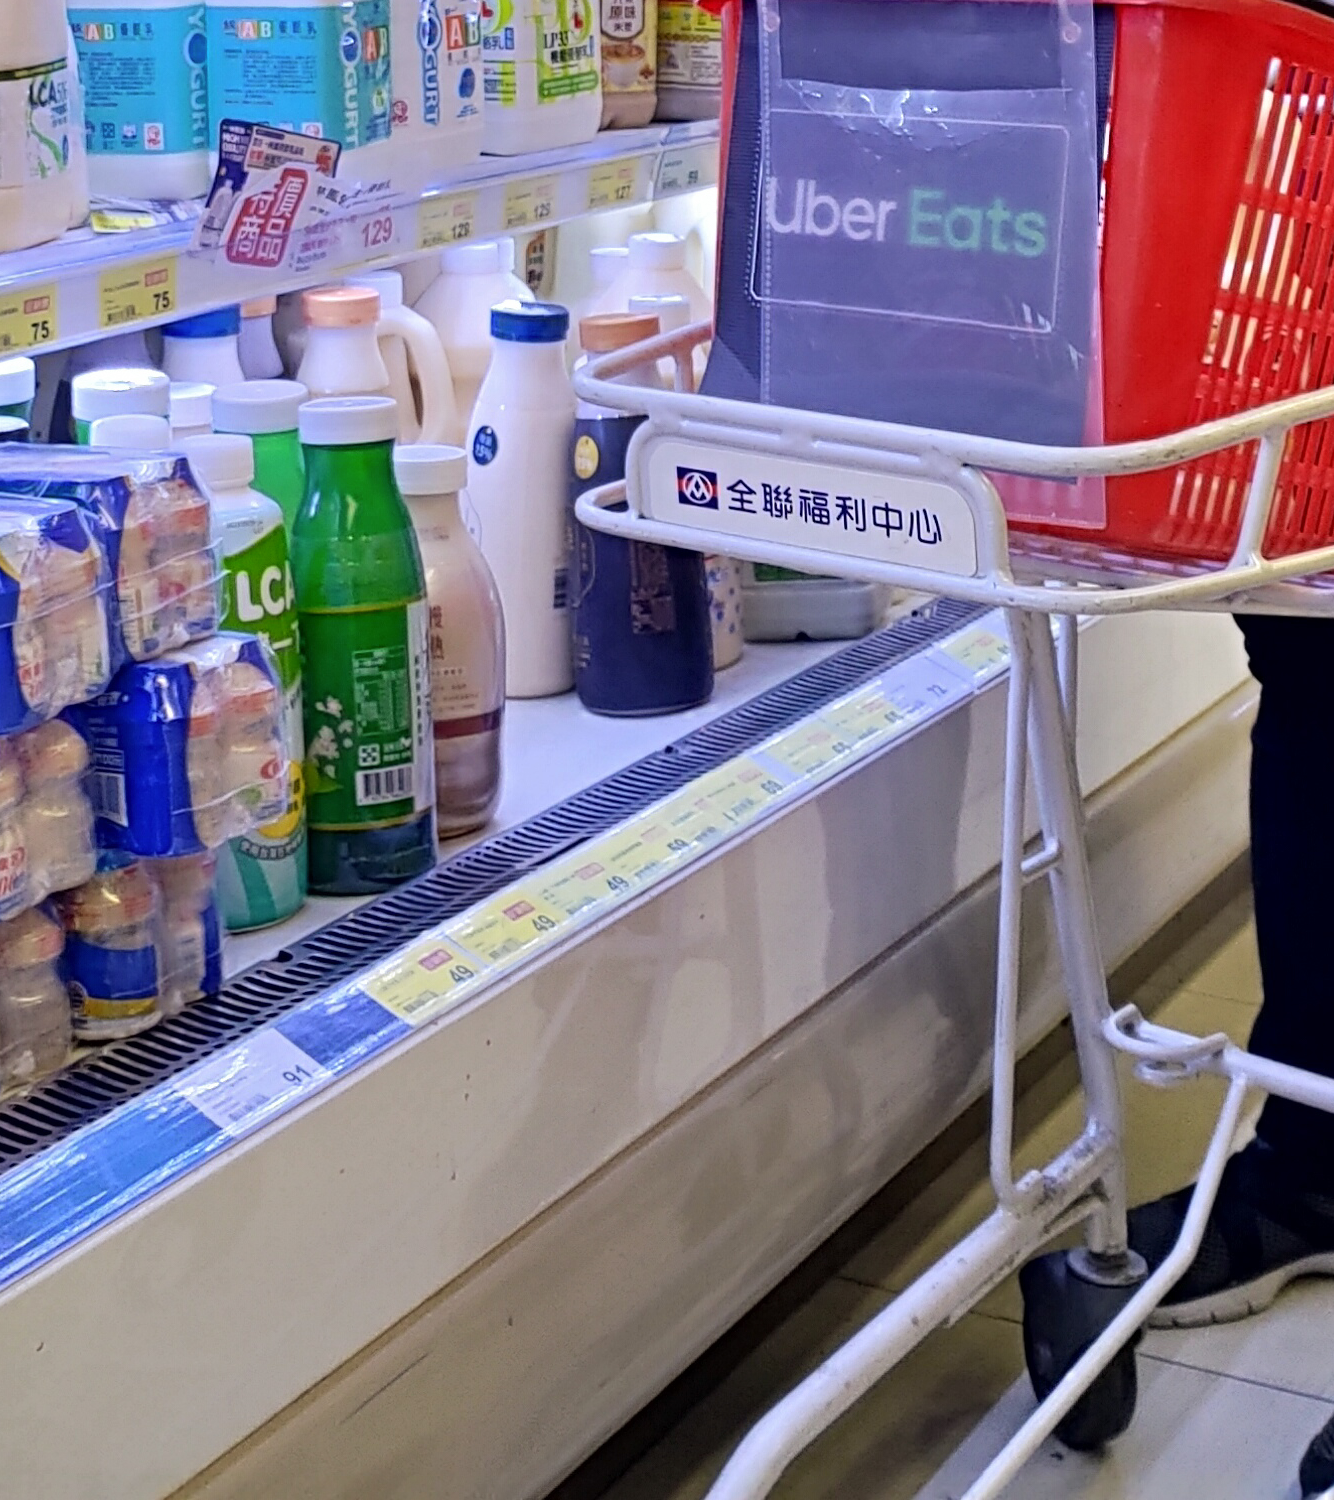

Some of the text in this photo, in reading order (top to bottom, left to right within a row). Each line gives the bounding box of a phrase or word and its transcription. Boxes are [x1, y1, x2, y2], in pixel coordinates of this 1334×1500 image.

[608, 5, 637, 22] 原味
[769, 178, 1047, 258] Uber Eats
[233, 218, 283, 263] 商品
[361, 216, 394, 248] 129
[153, 291, 170, 312] 75
[30, 320, 50, 341] 75
[726, 478, 943, 546] 全聯福利中心
[607, 876, 628, 891] 49
[532, 915, 555, 931] 49
[449, 964, 474, 983] 49
[282, 1064, 312, 1083] 91
